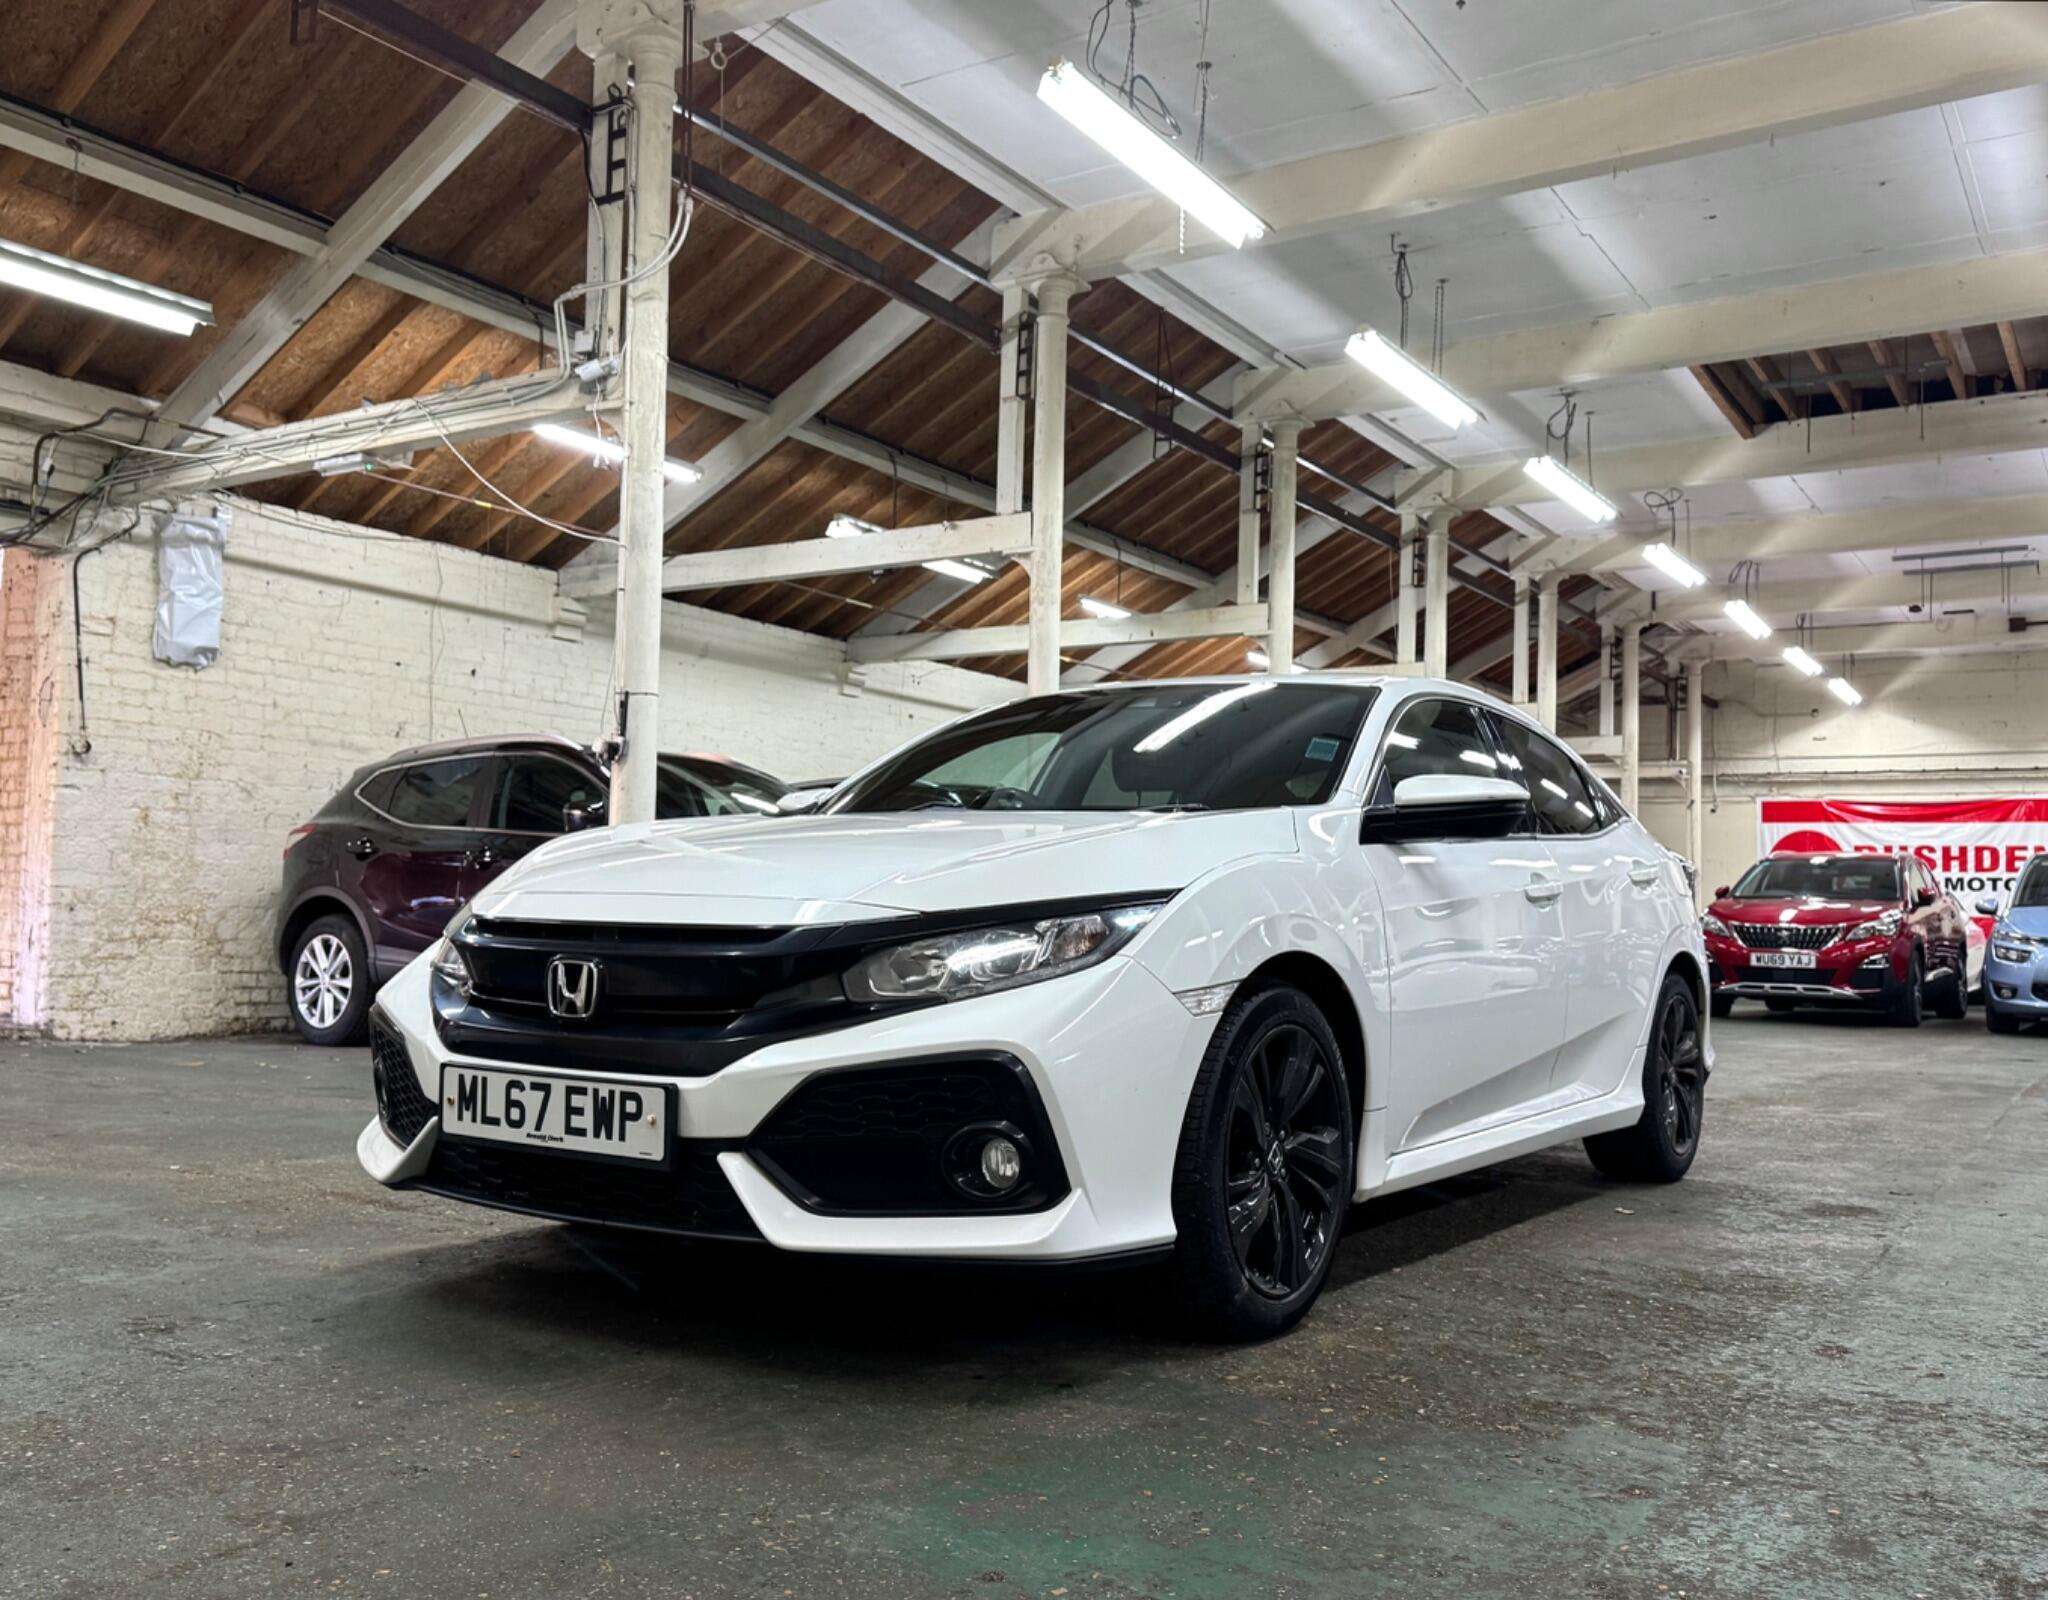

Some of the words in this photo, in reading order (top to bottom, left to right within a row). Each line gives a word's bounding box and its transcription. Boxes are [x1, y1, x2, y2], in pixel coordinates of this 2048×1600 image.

[1854, 845, 2047, 873] SHDE
[1789, 954, 1812, 966] YAJ
[457, 1073, 552, 1132] ML67
[564, 1085, 644, 1143] EWP
